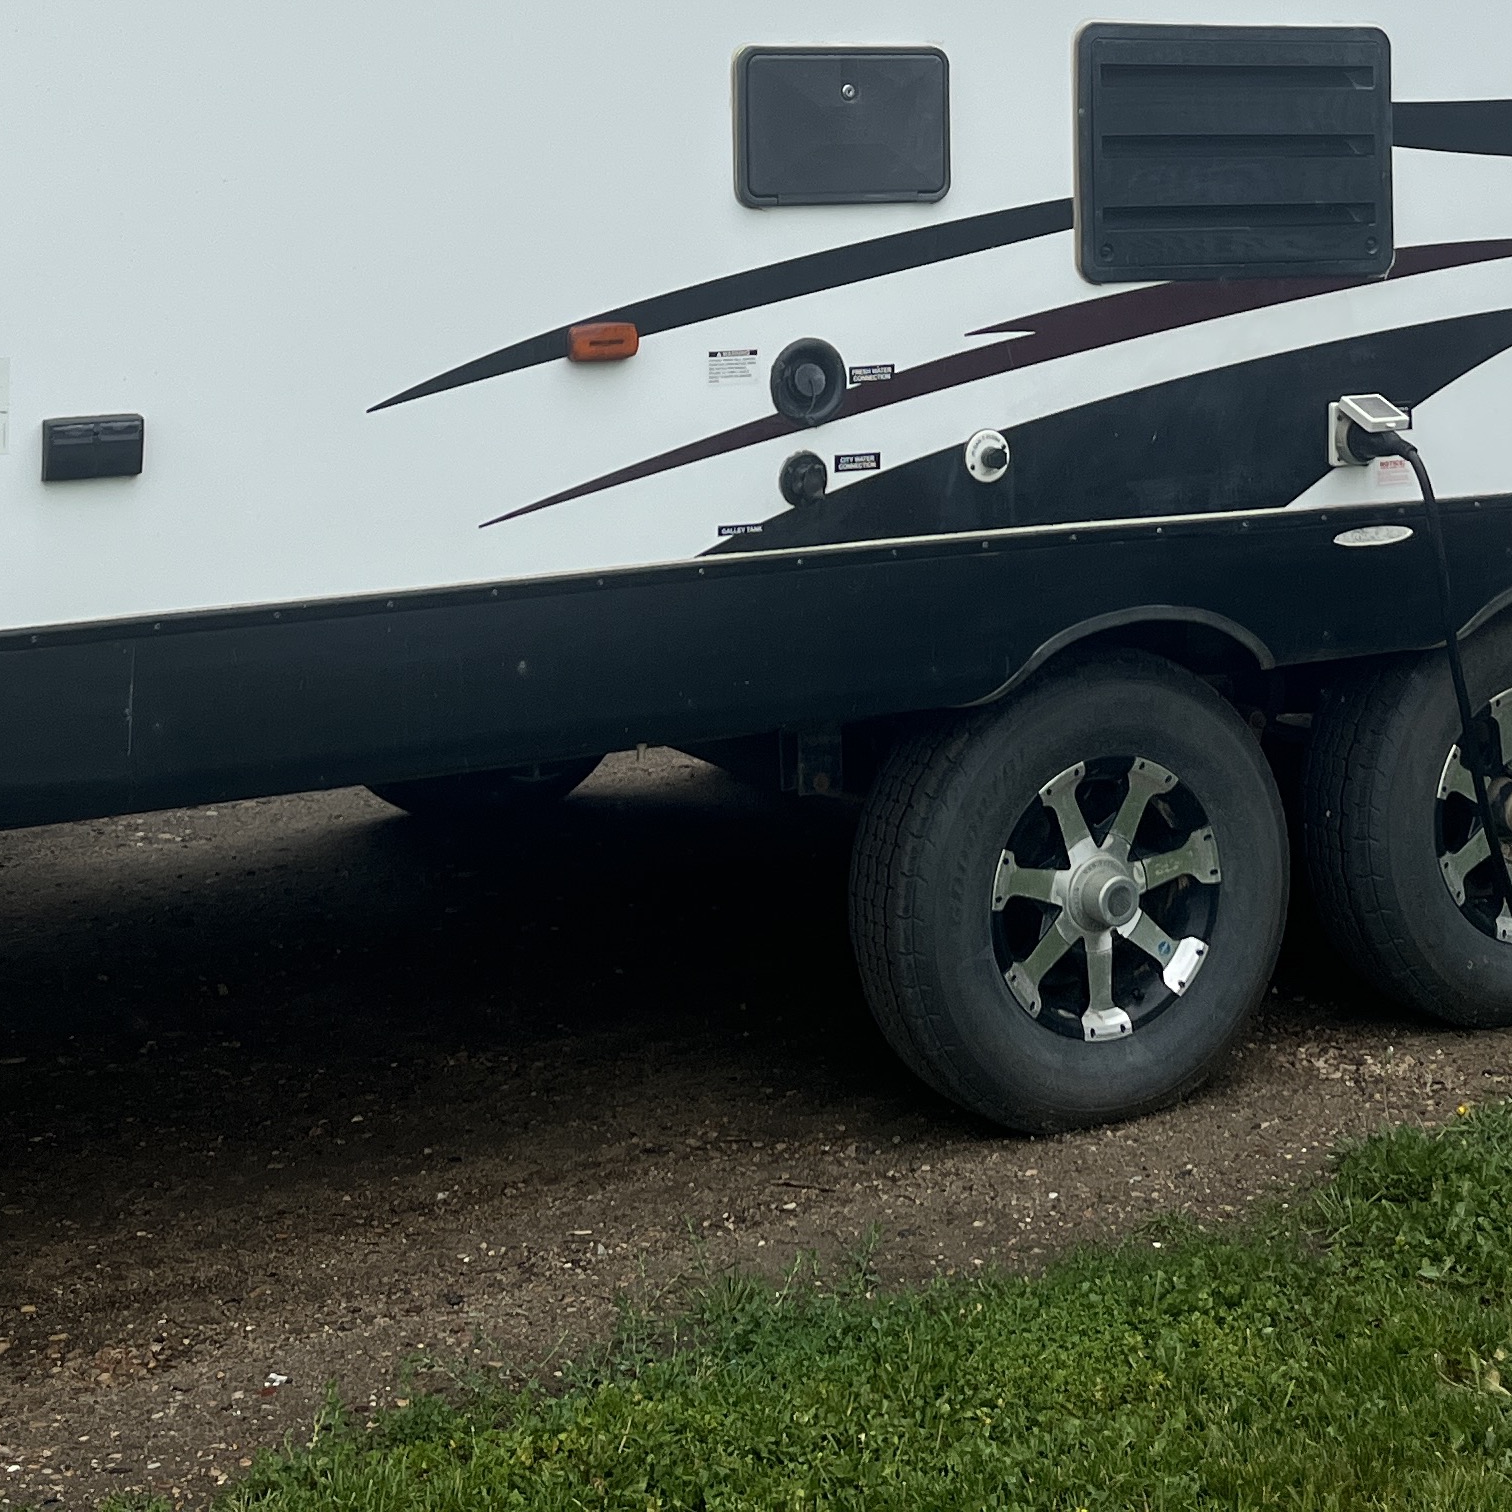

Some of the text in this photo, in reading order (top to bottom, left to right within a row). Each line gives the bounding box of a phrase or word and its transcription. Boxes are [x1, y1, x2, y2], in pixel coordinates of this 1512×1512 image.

[871, 366, 892, 374] WATER
[852, 373, 891, 382] CONNECTION
[838, 461, 876, 470] CONNECTION
[1379, 460, 1405, 468] NOTICE
